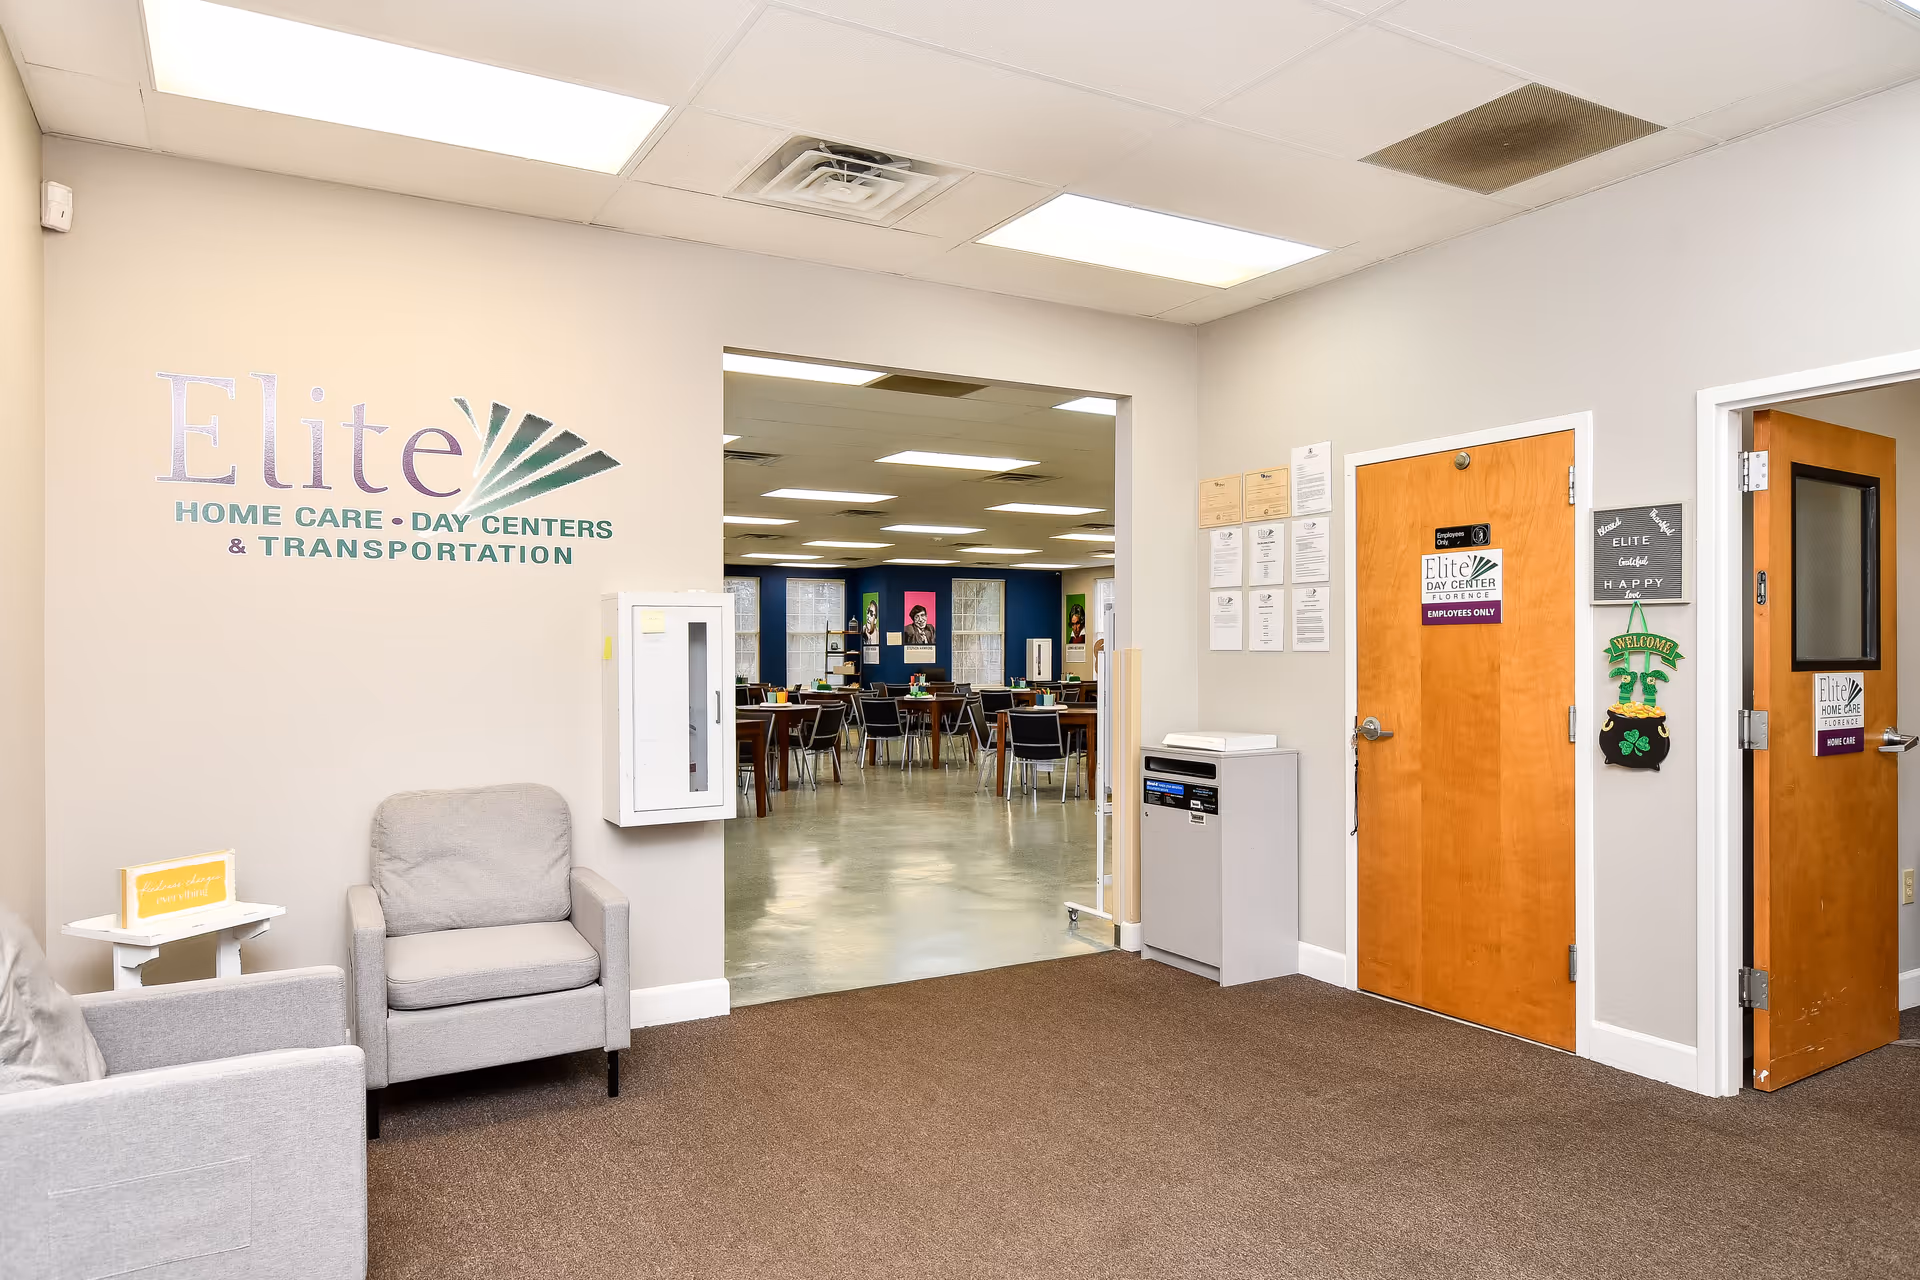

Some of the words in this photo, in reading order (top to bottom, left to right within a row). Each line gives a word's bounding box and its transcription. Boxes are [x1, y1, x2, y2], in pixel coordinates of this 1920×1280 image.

[155, 371, 464, 499] Elite
[174, 501, 282, 527] HOME
[294, 506, 383, 531] CARE
[411, 511, 470, 533] DAY
[481, 515, 614, 540] CENTERS
[1436, 531, 1465, 539] Employees
[1612, 536, 1651, 547] ELITE
[227, 537, 247, 555] &
[257, 535, 574, 565] TRANSPORTATION
[1425, 555, 1470, 580] Elite
[1426, 581, 1447, 591] DAY
[1450, 578, 1496, 589] CENTER
[1604, 578, 1663, 590] HAPPY
[1432, 592, 1489, 600] FLORENCE
[1624, 590, 1641, 599] Love
[1427, 609, 1472, 618] EMPLOYEES
[1473, 608, 1495, 616] ONLY
[1613, 635, 1674, 654] WELCOME
[1819, 676, 1847, 702] Elite
[1821, 704, 1841, 716] HOME
[1843, 703, 1861, 714] CARE
[1825, 718, 1858, 727] FLORENCE
[1827, 738, 1842, 747] HOME
[1842, 736, 1856, 745] CARE
